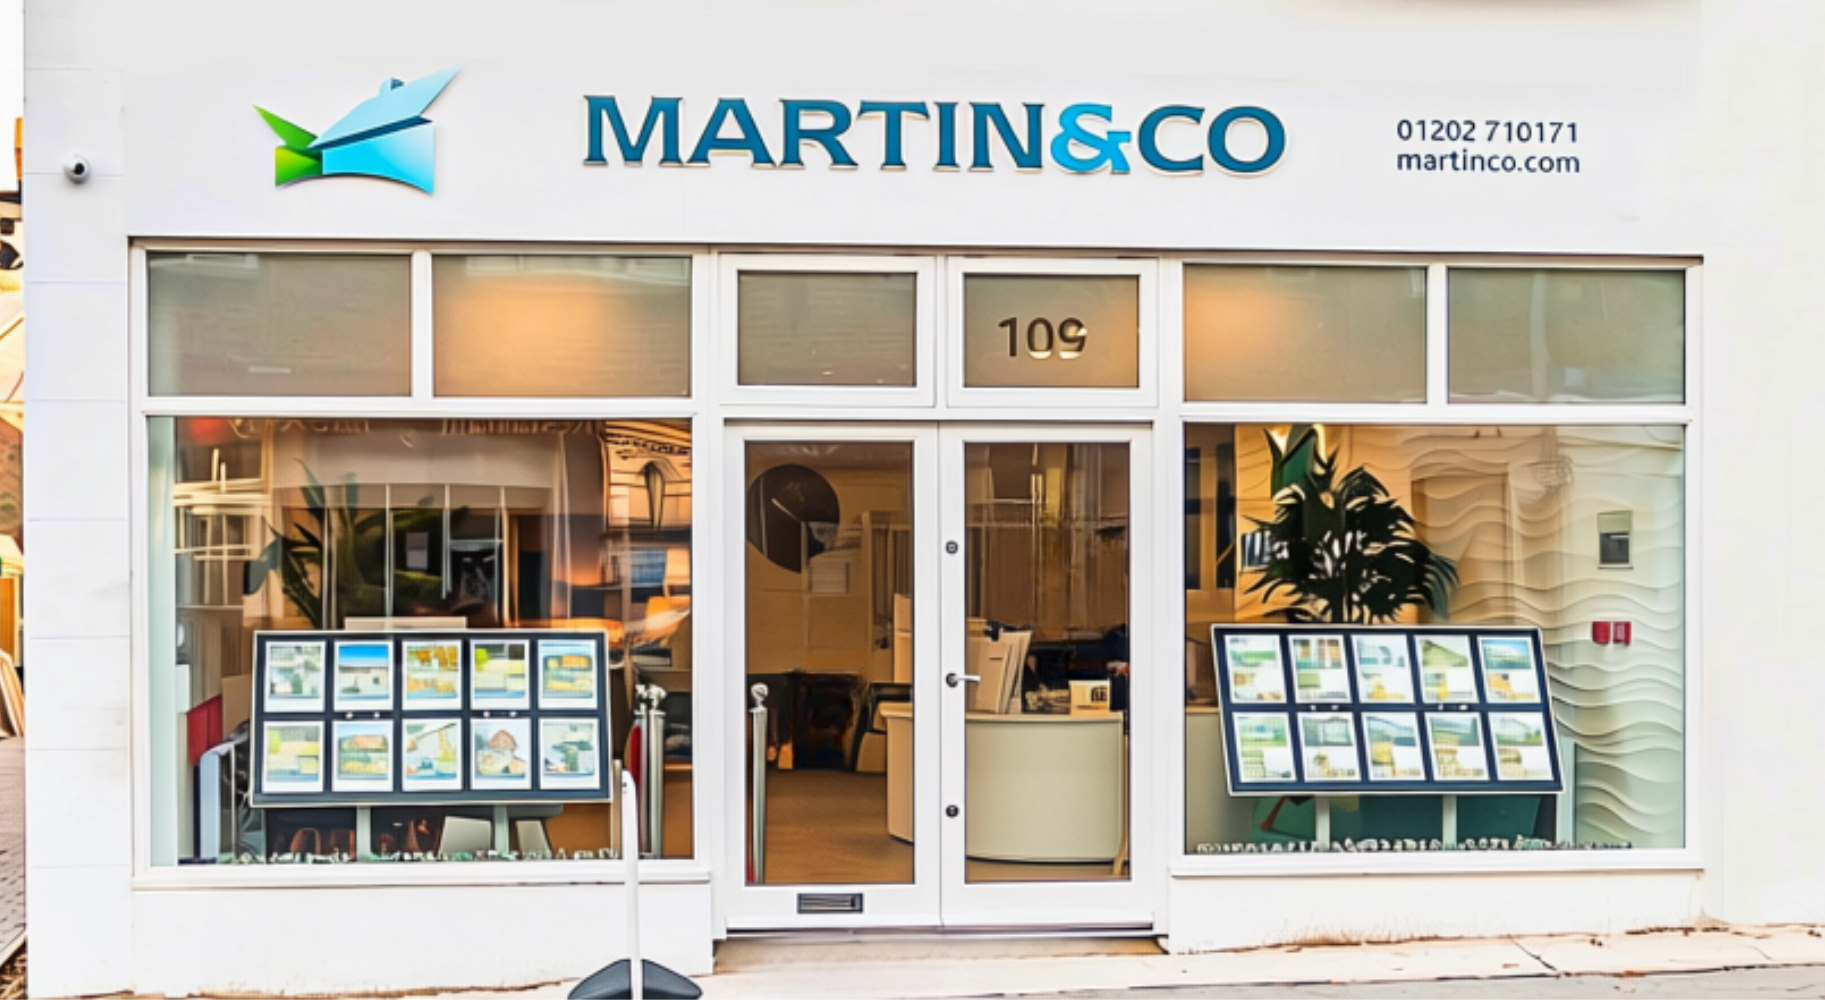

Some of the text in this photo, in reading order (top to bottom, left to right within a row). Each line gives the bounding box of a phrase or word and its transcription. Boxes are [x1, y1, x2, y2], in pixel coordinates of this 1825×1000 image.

[583, 94, 1286, 176] MARTIN&CO
[1397, 119, 1577, 143] 01202 710171
[1397, 147, 1580, 173] martinco.com
[998, 317, 1088, 359] 109
